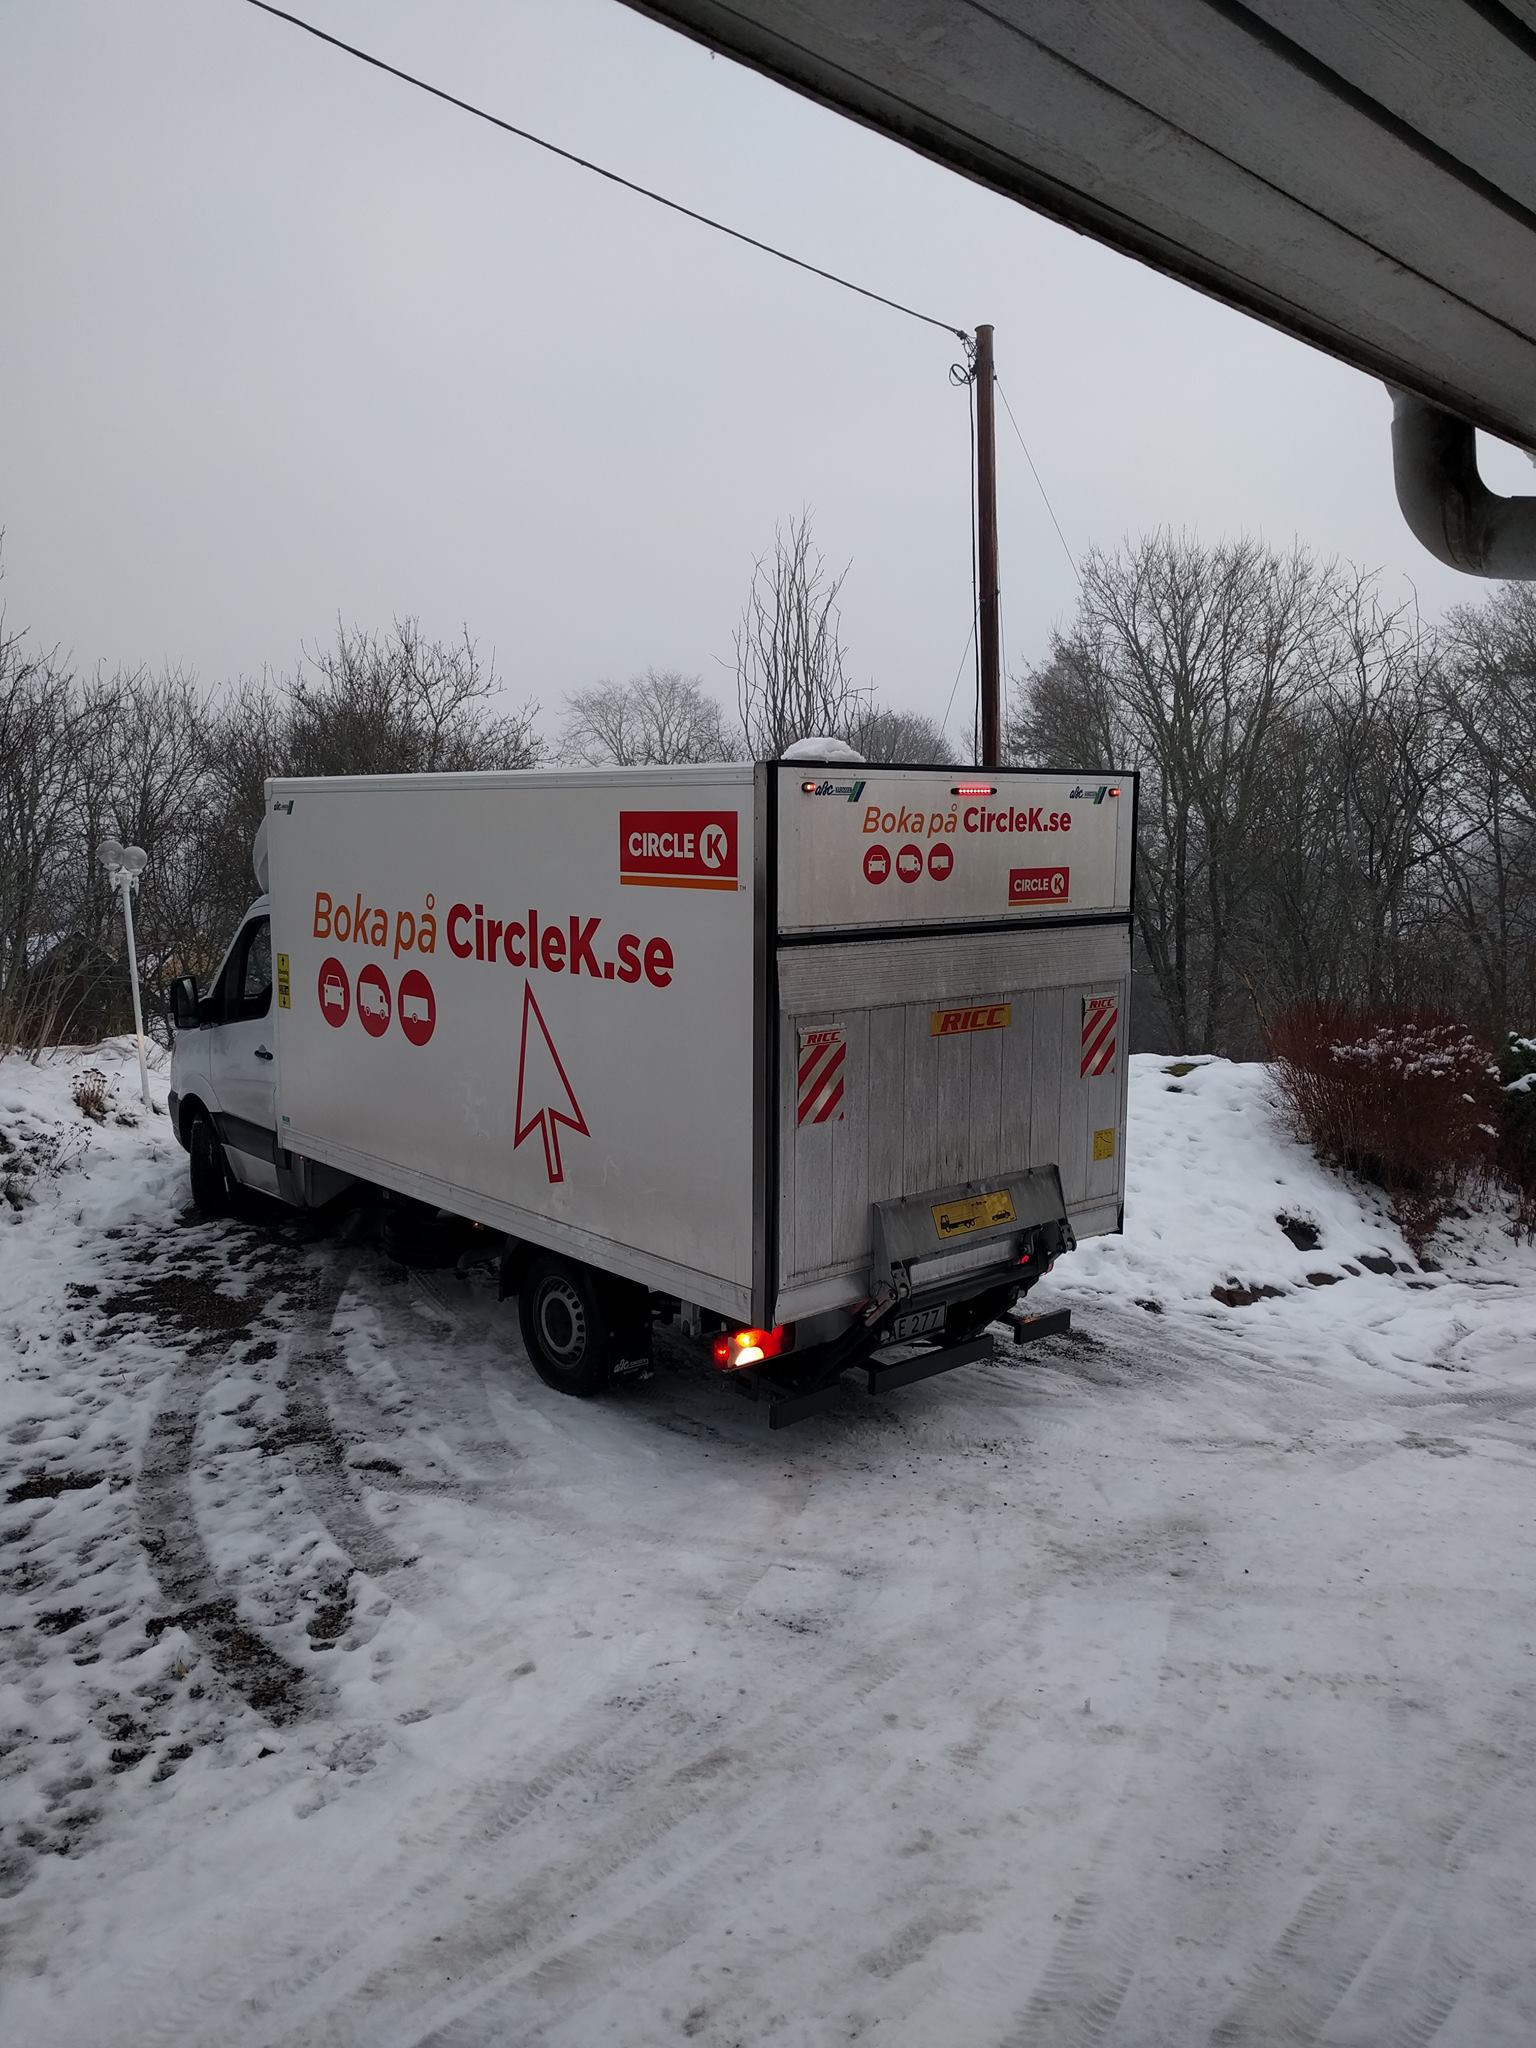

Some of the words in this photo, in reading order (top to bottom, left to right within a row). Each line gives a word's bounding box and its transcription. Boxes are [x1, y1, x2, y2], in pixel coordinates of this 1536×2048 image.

[862, 806, 923, 834] Boka
[927, 803, 958, 839] på
[963, 806, 1072, 833] CircleK.se
[628, 831, 695, 859] CIRCLE
[1014, 878, 1049, 892] CIRCLE
[312, 891, 388, 949] Boka
[393, 893, 438, 959] på
[446, 903, 675, 988] CircleK.se
[1088, 998, 1114, 1010] RICC
[939, 1007, 1006, 1033] RICC
[806, 1031, 841, 1044] RICC
[911, 1309, 940, 1334] 277
